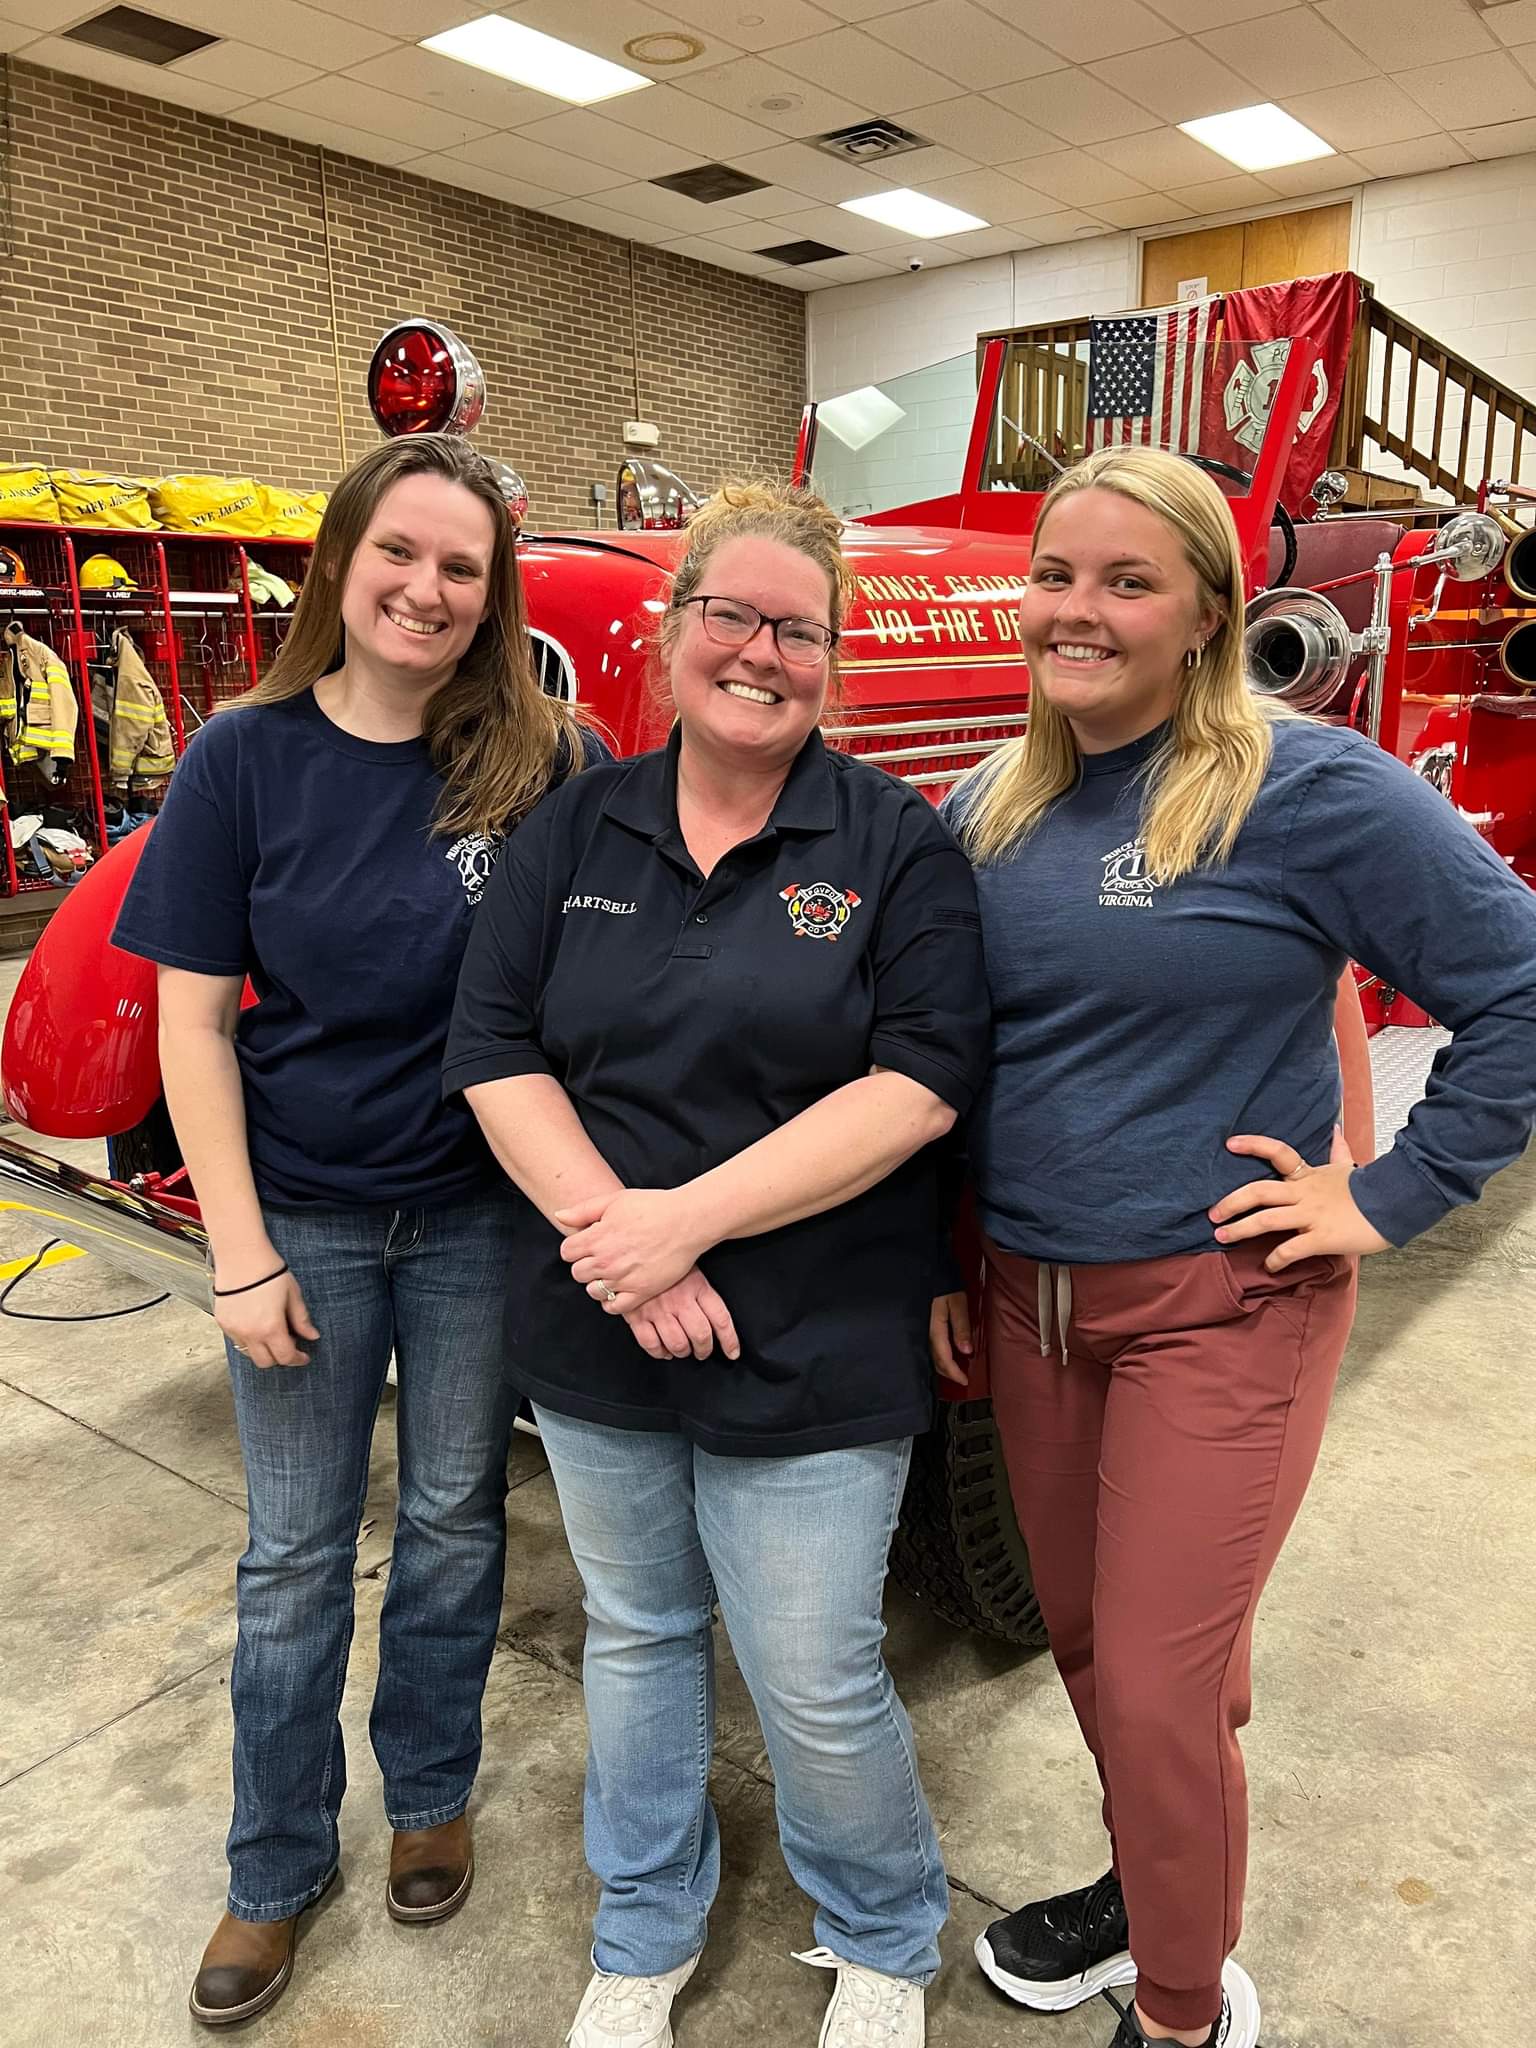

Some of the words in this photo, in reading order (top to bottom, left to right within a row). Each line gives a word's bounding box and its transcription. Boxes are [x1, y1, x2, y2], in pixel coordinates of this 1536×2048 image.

[864, 609, 924, 644] VOL
[926, 608, 988, 642] FIRE
[480, 852, 491, 877] 1
[1126, 854, 1142, 876] 1
[1114, 882, 1145, 890] TRUCK
[1099, 895, 1153, 907] VIRGINIA
